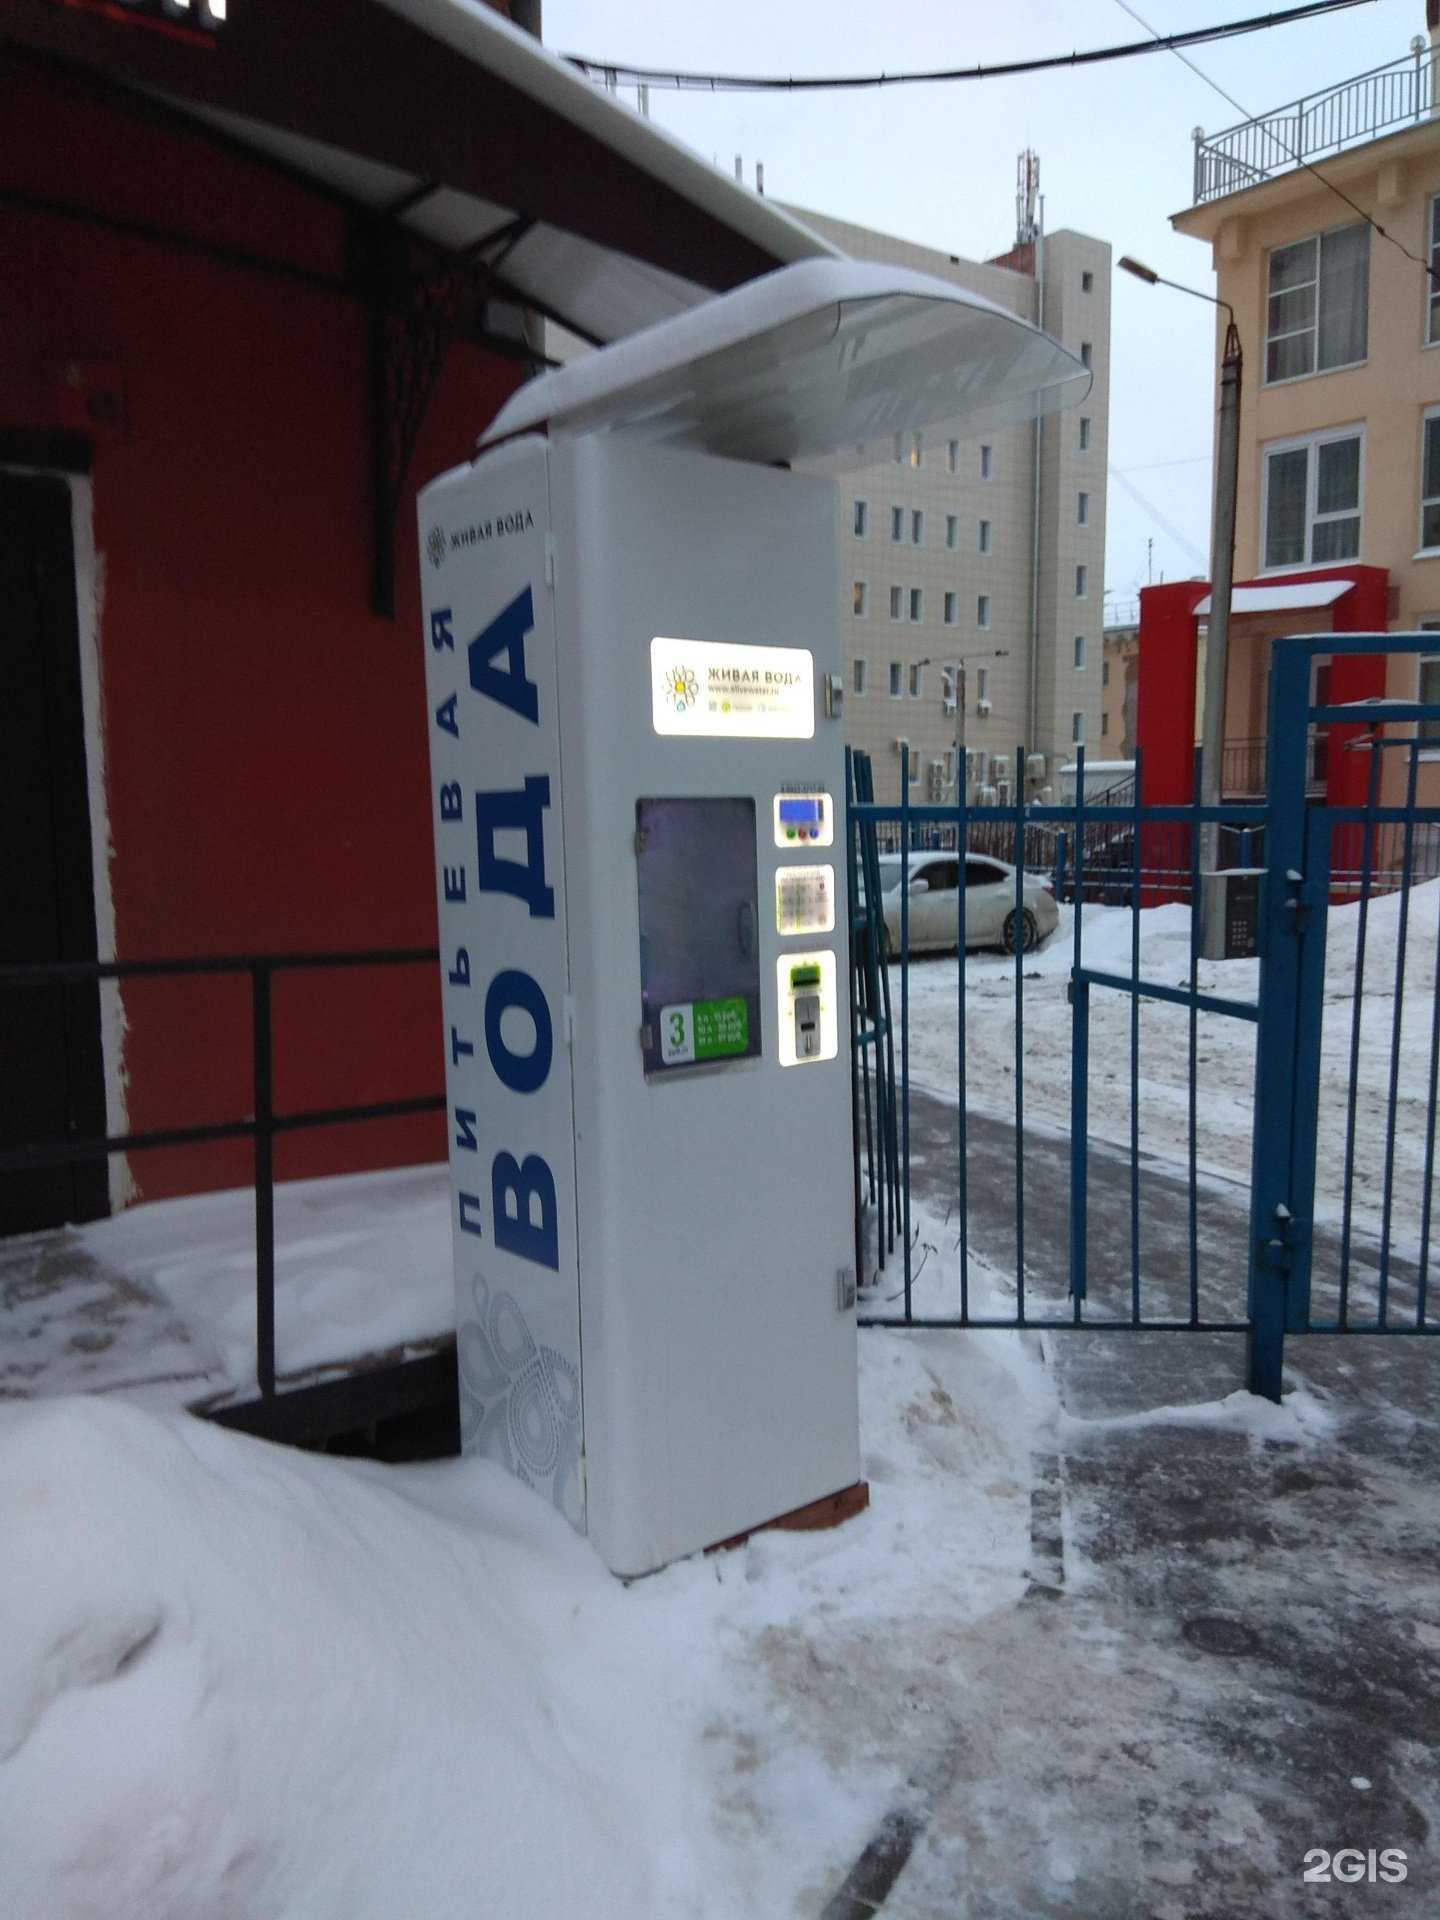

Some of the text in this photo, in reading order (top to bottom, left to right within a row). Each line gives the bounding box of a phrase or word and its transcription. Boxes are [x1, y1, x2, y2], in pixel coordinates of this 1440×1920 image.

[450, 508, 535, 551] ЖИВАЯ ВОДА
[707, 666, 802, 686] ЖИВАЯ ВОДА
[430, 606, 482, 1238] ПИТЬЕВАЯ
[468, 583, 560, 1273] ВОДА
[669, 1011, 685, 1047] 3
